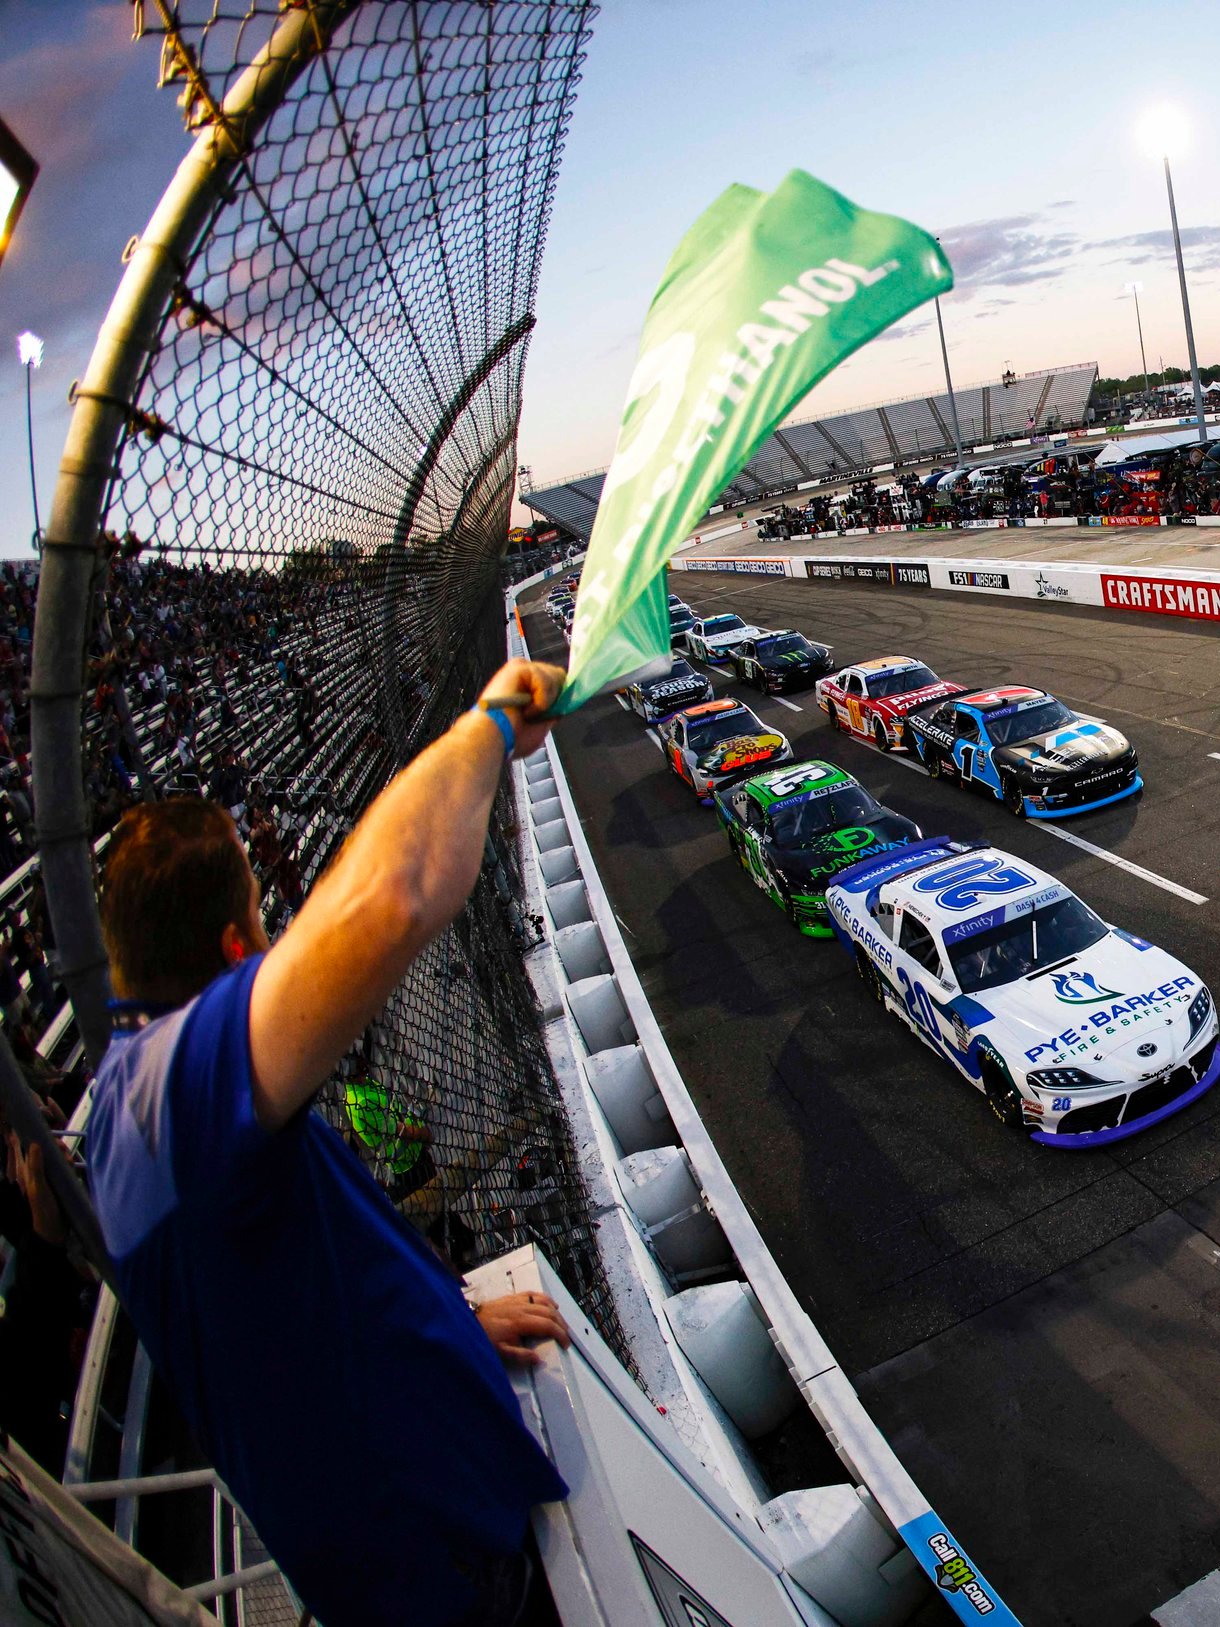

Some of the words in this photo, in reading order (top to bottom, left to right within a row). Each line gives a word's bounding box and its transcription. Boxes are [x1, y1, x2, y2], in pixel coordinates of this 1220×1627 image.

[819, 467, 873, 484] MARTINSVILLE
[750, 561, 766, 573] GEICO
[766, 561, 784, 575] GEICO
[857, 568, 873, 577] GEICO
[898, 568, 907, 582] 75
[908, 569, 928, 583] YEARS
[953, 572, 968, 585] FS1
[975, 574, 1003, 588] NASCAR
[987, 708, 1012, 718] xfinity
[1026, 699, 1047, 707] MAYER
[961, 744, 976, 782] 1
[1074, 767, 1124, 788] CAMARO
[1041, 787, 1049, 796] 1
[774, 796, 804, 809] xfinity
[811, 836, 909, 878] FUNKAWAY
[913, 855, 1038, 912] 20
[1015, 899, 1035, 914] DASH
[1043, 889, 1060, 903] CASH
[835, 895, 851, 923] PYE
[851, 919, 893, 969] BARKER
[952, 914, 995, 937] xfinity
[896, 966, 943, 1042] 20
[1024, 1028, 1082, 1064] PYE
[1088, 976, 1196, 1028] BARKER
[1058, 1034, 1100, 1062] FIRE
[1105, 1026, 1116, 1035] &
[1120, 996, 1183, 1027] SAFETY
[1138, 1062, 1176, 1082] Supra
[1052, 1096, 1072, 1112] 20
[929, 1534, 994, 1614] Call811.com
